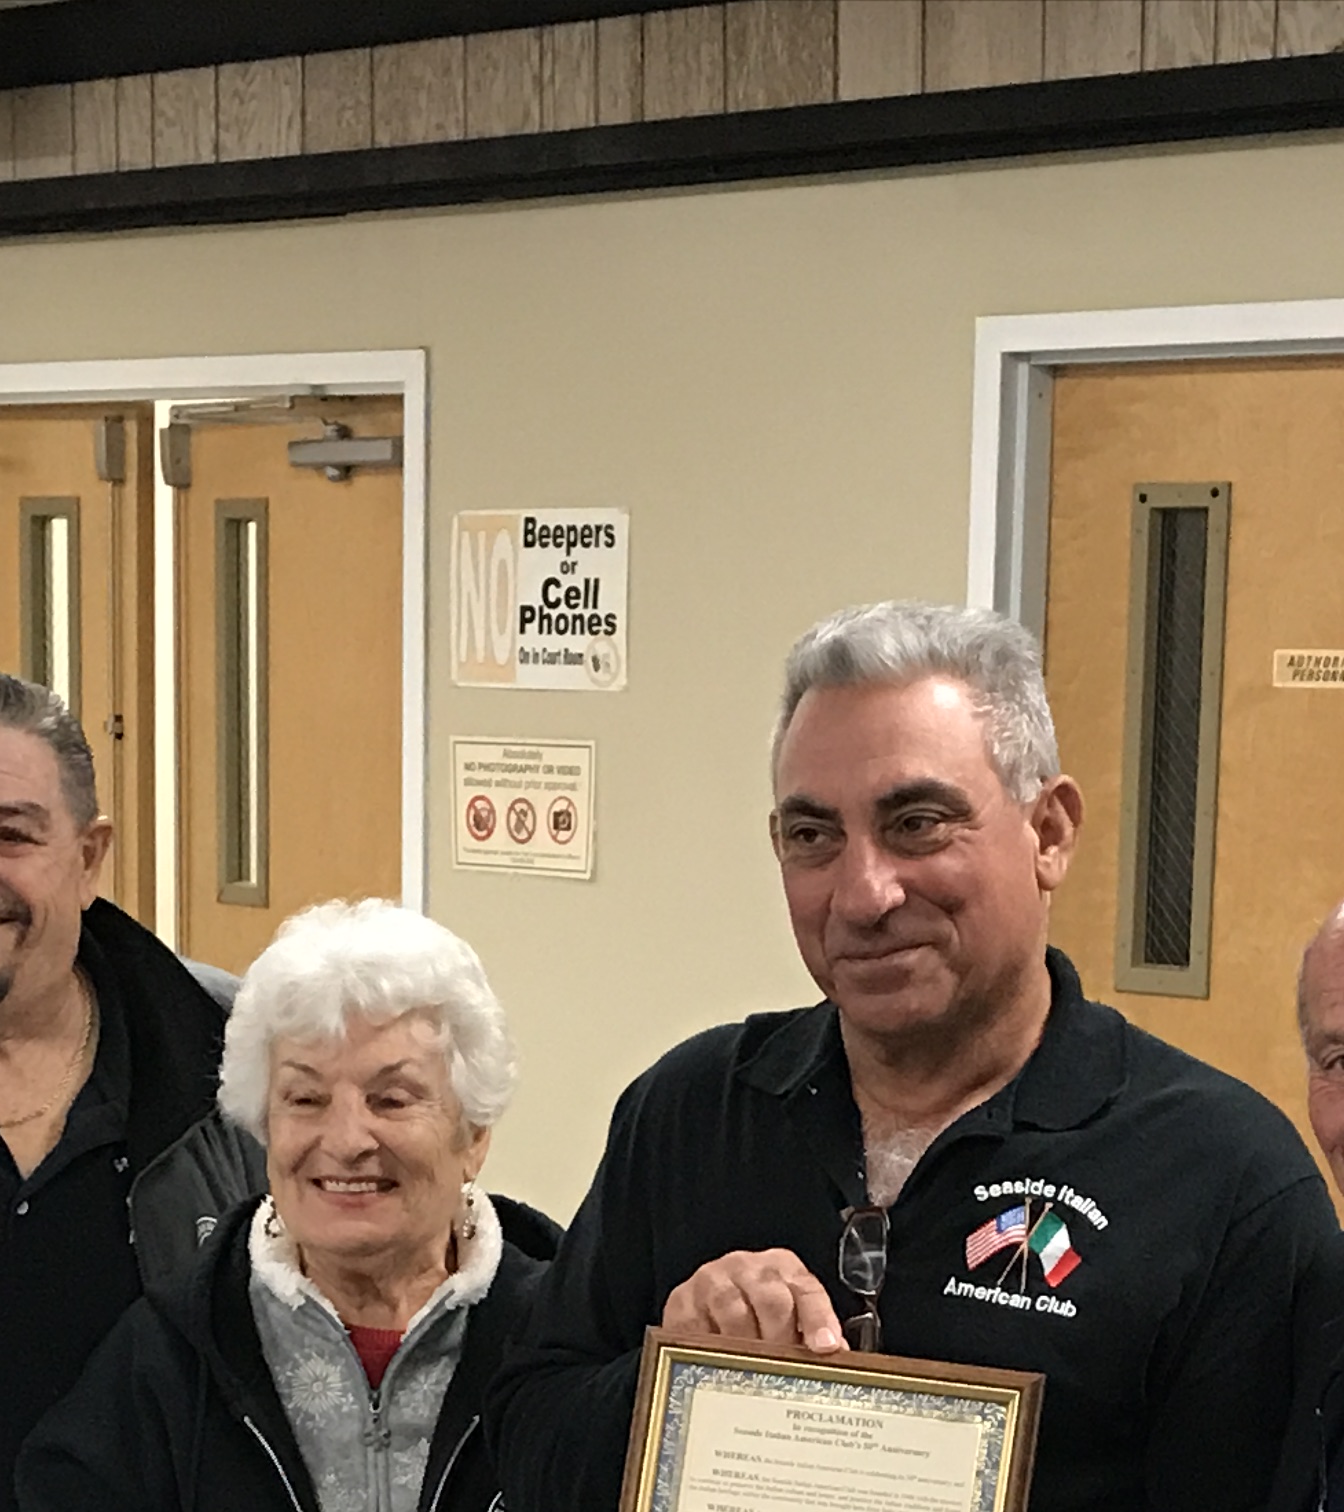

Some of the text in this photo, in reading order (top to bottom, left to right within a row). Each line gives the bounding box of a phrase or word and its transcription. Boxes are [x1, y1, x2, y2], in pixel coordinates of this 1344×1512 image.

[523, 516, 616, 556] Beepers
[560, 560, 578, 576] or
[460, 527, 515, 666] NO
[542, 577, 600, 610] Cell
[519, 604, 618, 637] Phones
[477, 761, 540, 774] PHOTOGRAPHY
[973, 1177, 1109, 1231] Seaside Italian
[943, 1276, 1077, 1318] American Club
[785, 1408, 883, 1429] PROCLAMATION
